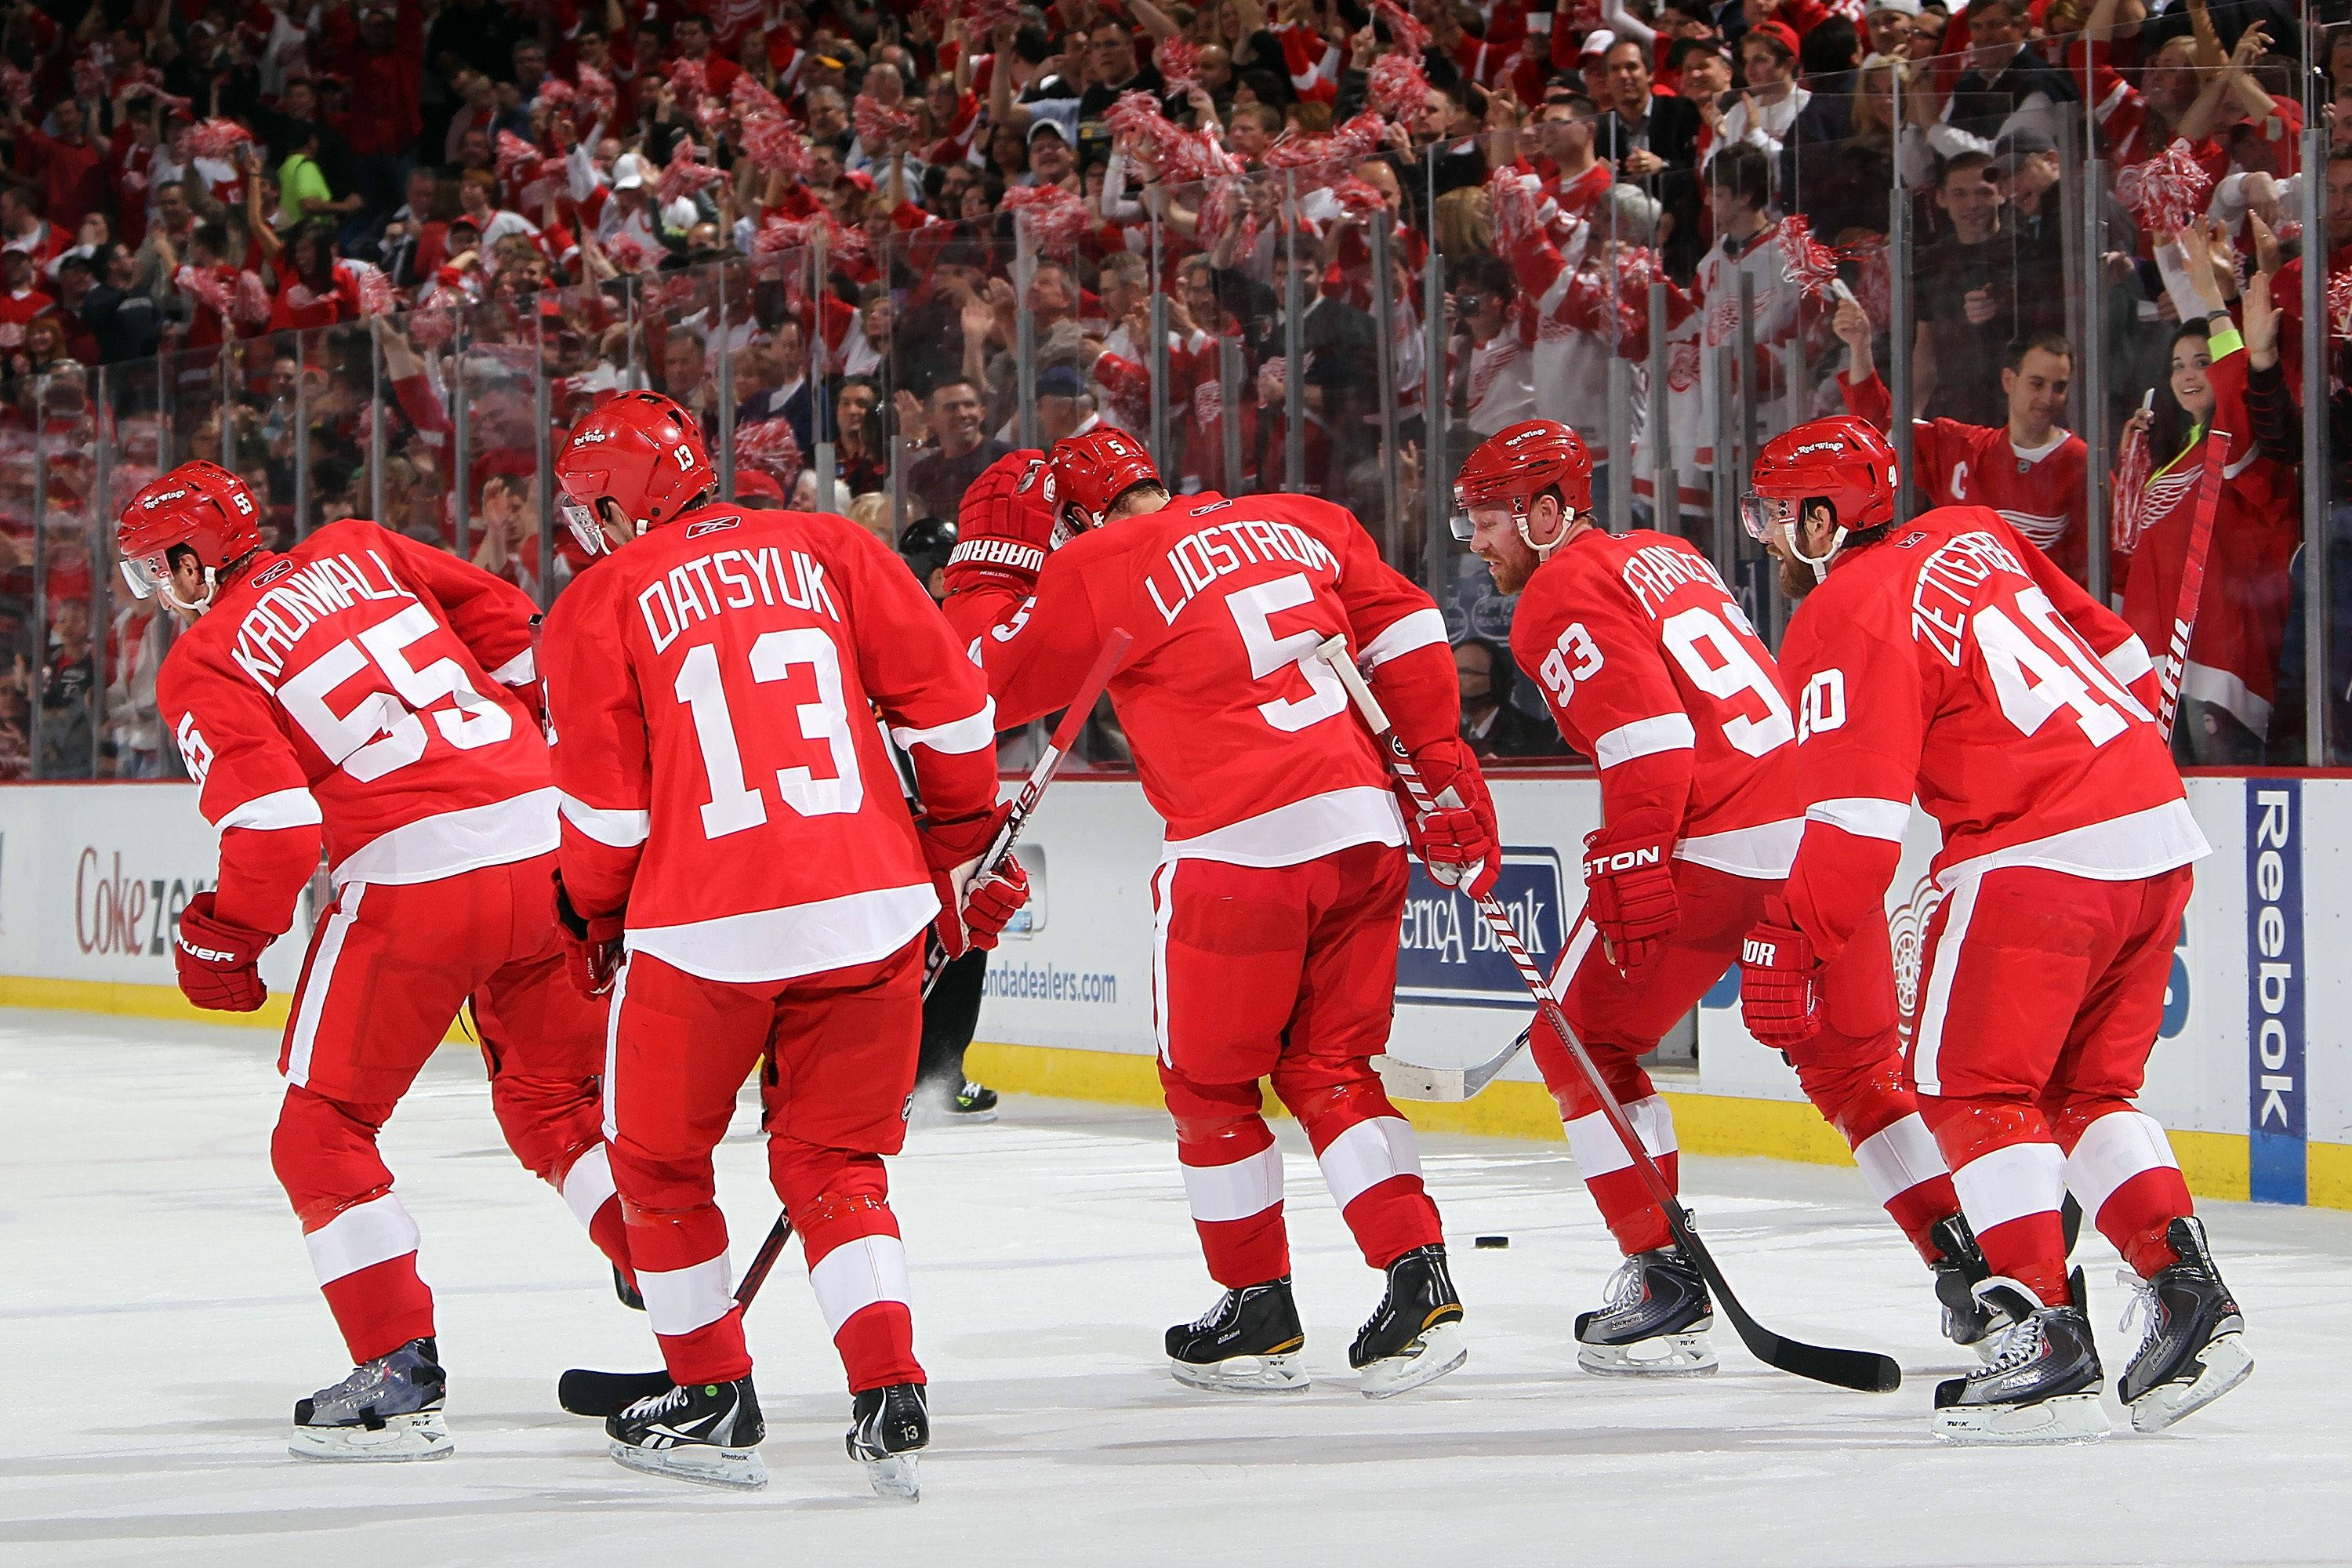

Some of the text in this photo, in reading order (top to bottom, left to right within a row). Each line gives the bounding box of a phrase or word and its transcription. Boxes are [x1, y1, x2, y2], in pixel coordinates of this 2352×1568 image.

[673, 444, 695, 472] 13
[1107, 440, 1127, 456] 5
[1505, 429, 1547, 446] Red Wings
[1797, 441, 1844, 454] Red Wings
[143, 489, 186, 510] Red Wings
[1951, 460, 1969, 499] C
[232, 492, 253, 516] 55
[1144, 519, 1341, 627] LIDSTROM
[231, 549, 420, 697] KRONWALL
[637, 546, 841, 655] DATSYUK
[991, 595, 1038, 643] 5
[1225, 572, 1348, 733] 5
[1539, 622, 1604, 708] 93
[276, 600, 513, 783] 55
[674, 626, 864, 840] 13
[75, 844, 219, 956] Coke ze
[2256, 789, 2293, 1129] Reebok
[721, 1452, 749, 1461] Reebok
[900, 1425, 920, 1441] 13
